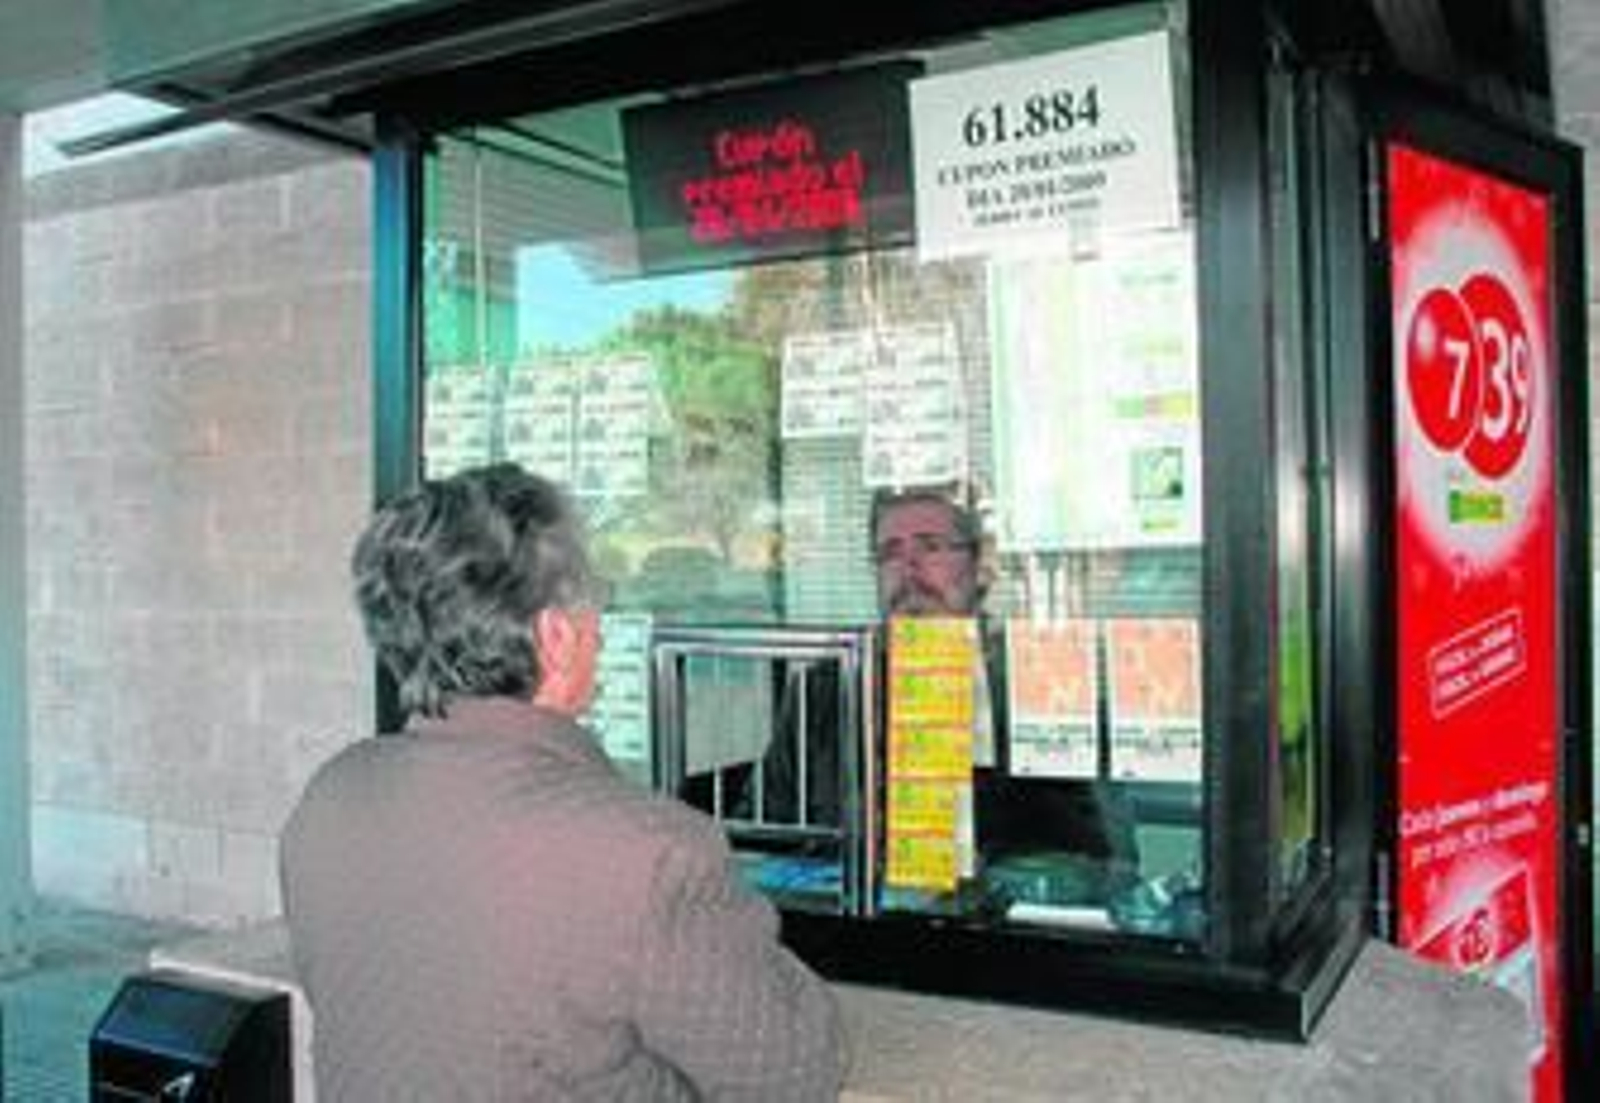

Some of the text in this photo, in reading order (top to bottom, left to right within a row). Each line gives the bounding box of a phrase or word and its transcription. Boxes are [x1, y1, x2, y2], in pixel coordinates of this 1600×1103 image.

[963, 84, 1100, 147] 61.884
[1014, 136, 1137, 175] PREMIADO
[1444, 317, 1532, 441] 7 39
